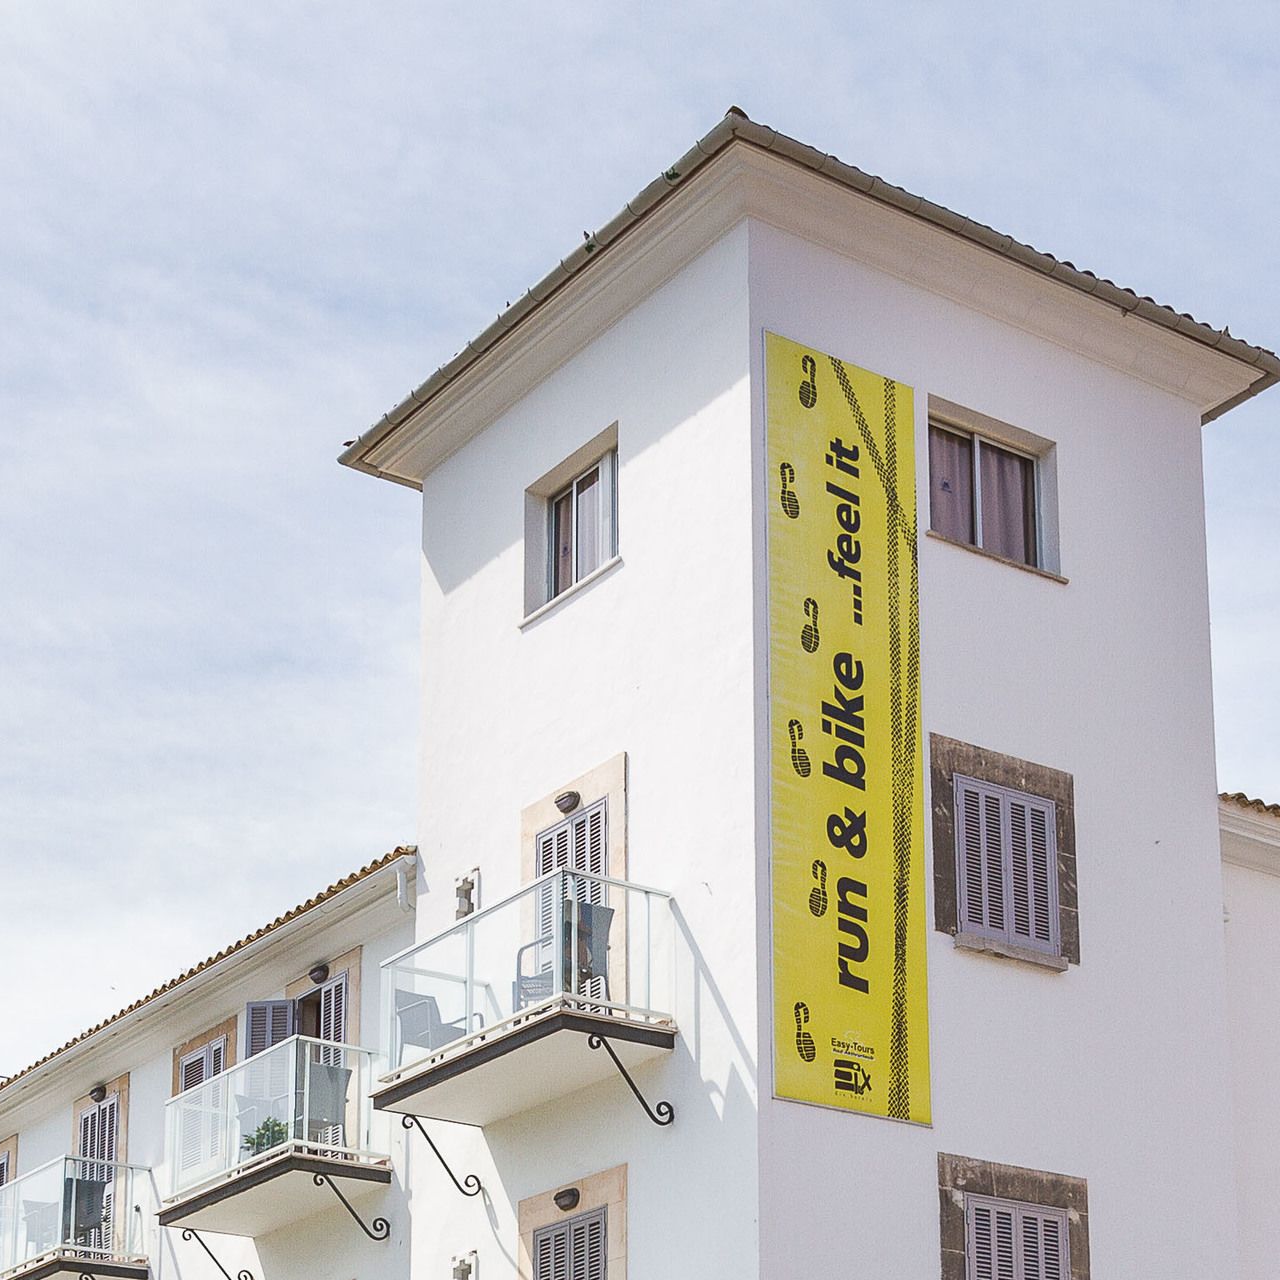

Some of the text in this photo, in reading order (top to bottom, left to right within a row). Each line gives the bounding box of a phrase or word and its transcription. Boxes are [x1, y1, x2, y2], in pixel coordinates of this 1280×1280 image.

[825, 437, 861, 480] it
[821, 652, 866, 792] bike
[826, 806, 868, 859] &
[836, 876, 870, 995] run
